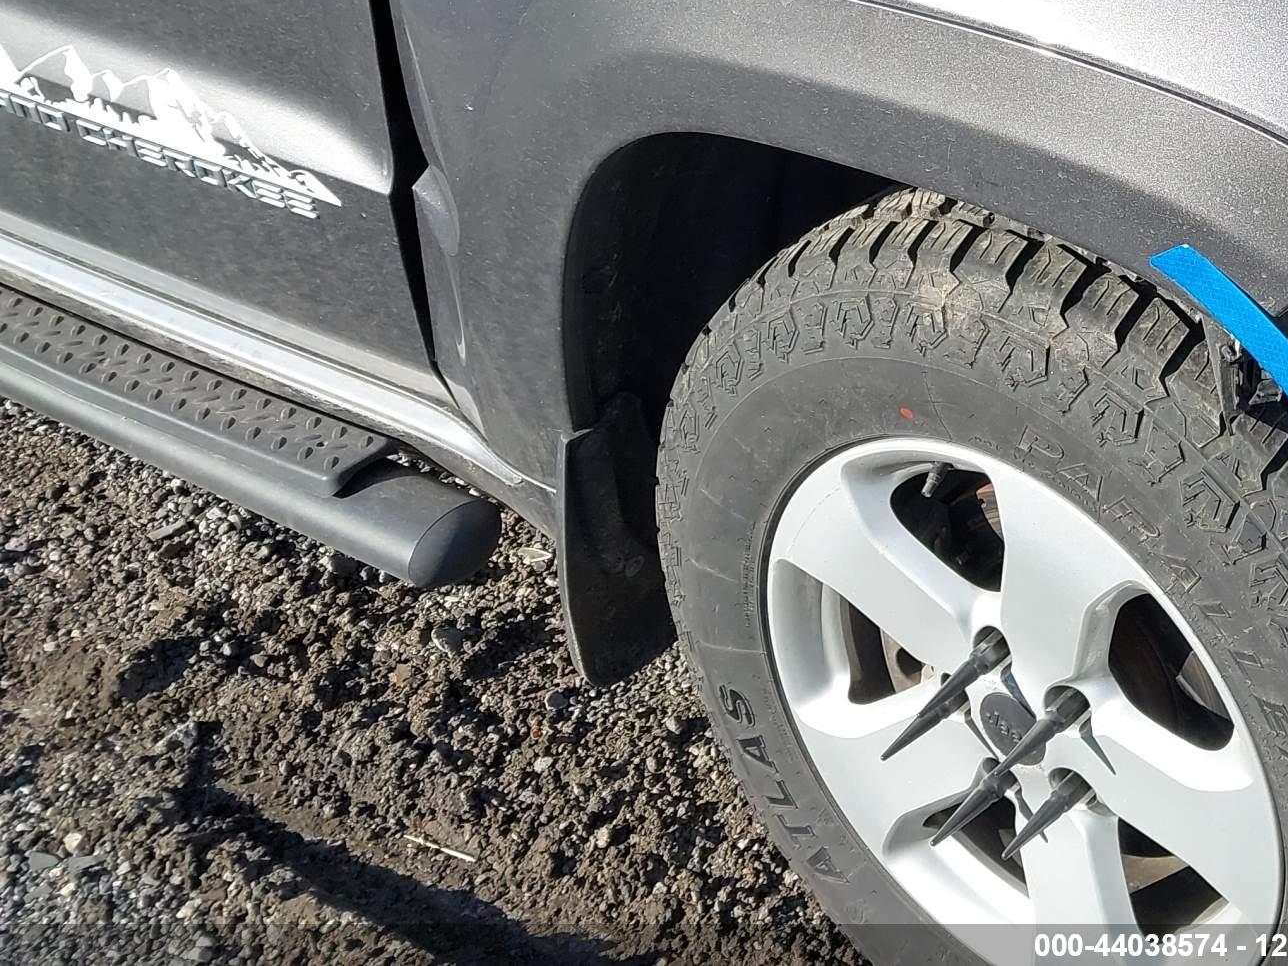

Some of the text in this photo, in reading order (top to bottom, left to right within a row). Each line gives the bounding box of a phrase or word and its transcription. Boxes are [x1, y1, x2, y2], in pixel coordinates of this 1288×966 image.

[76, 118, 320, 220] CHEROKEE
[985, 711, 1023, 744] Jee
[719, 684, 850, 884] ATLAS
